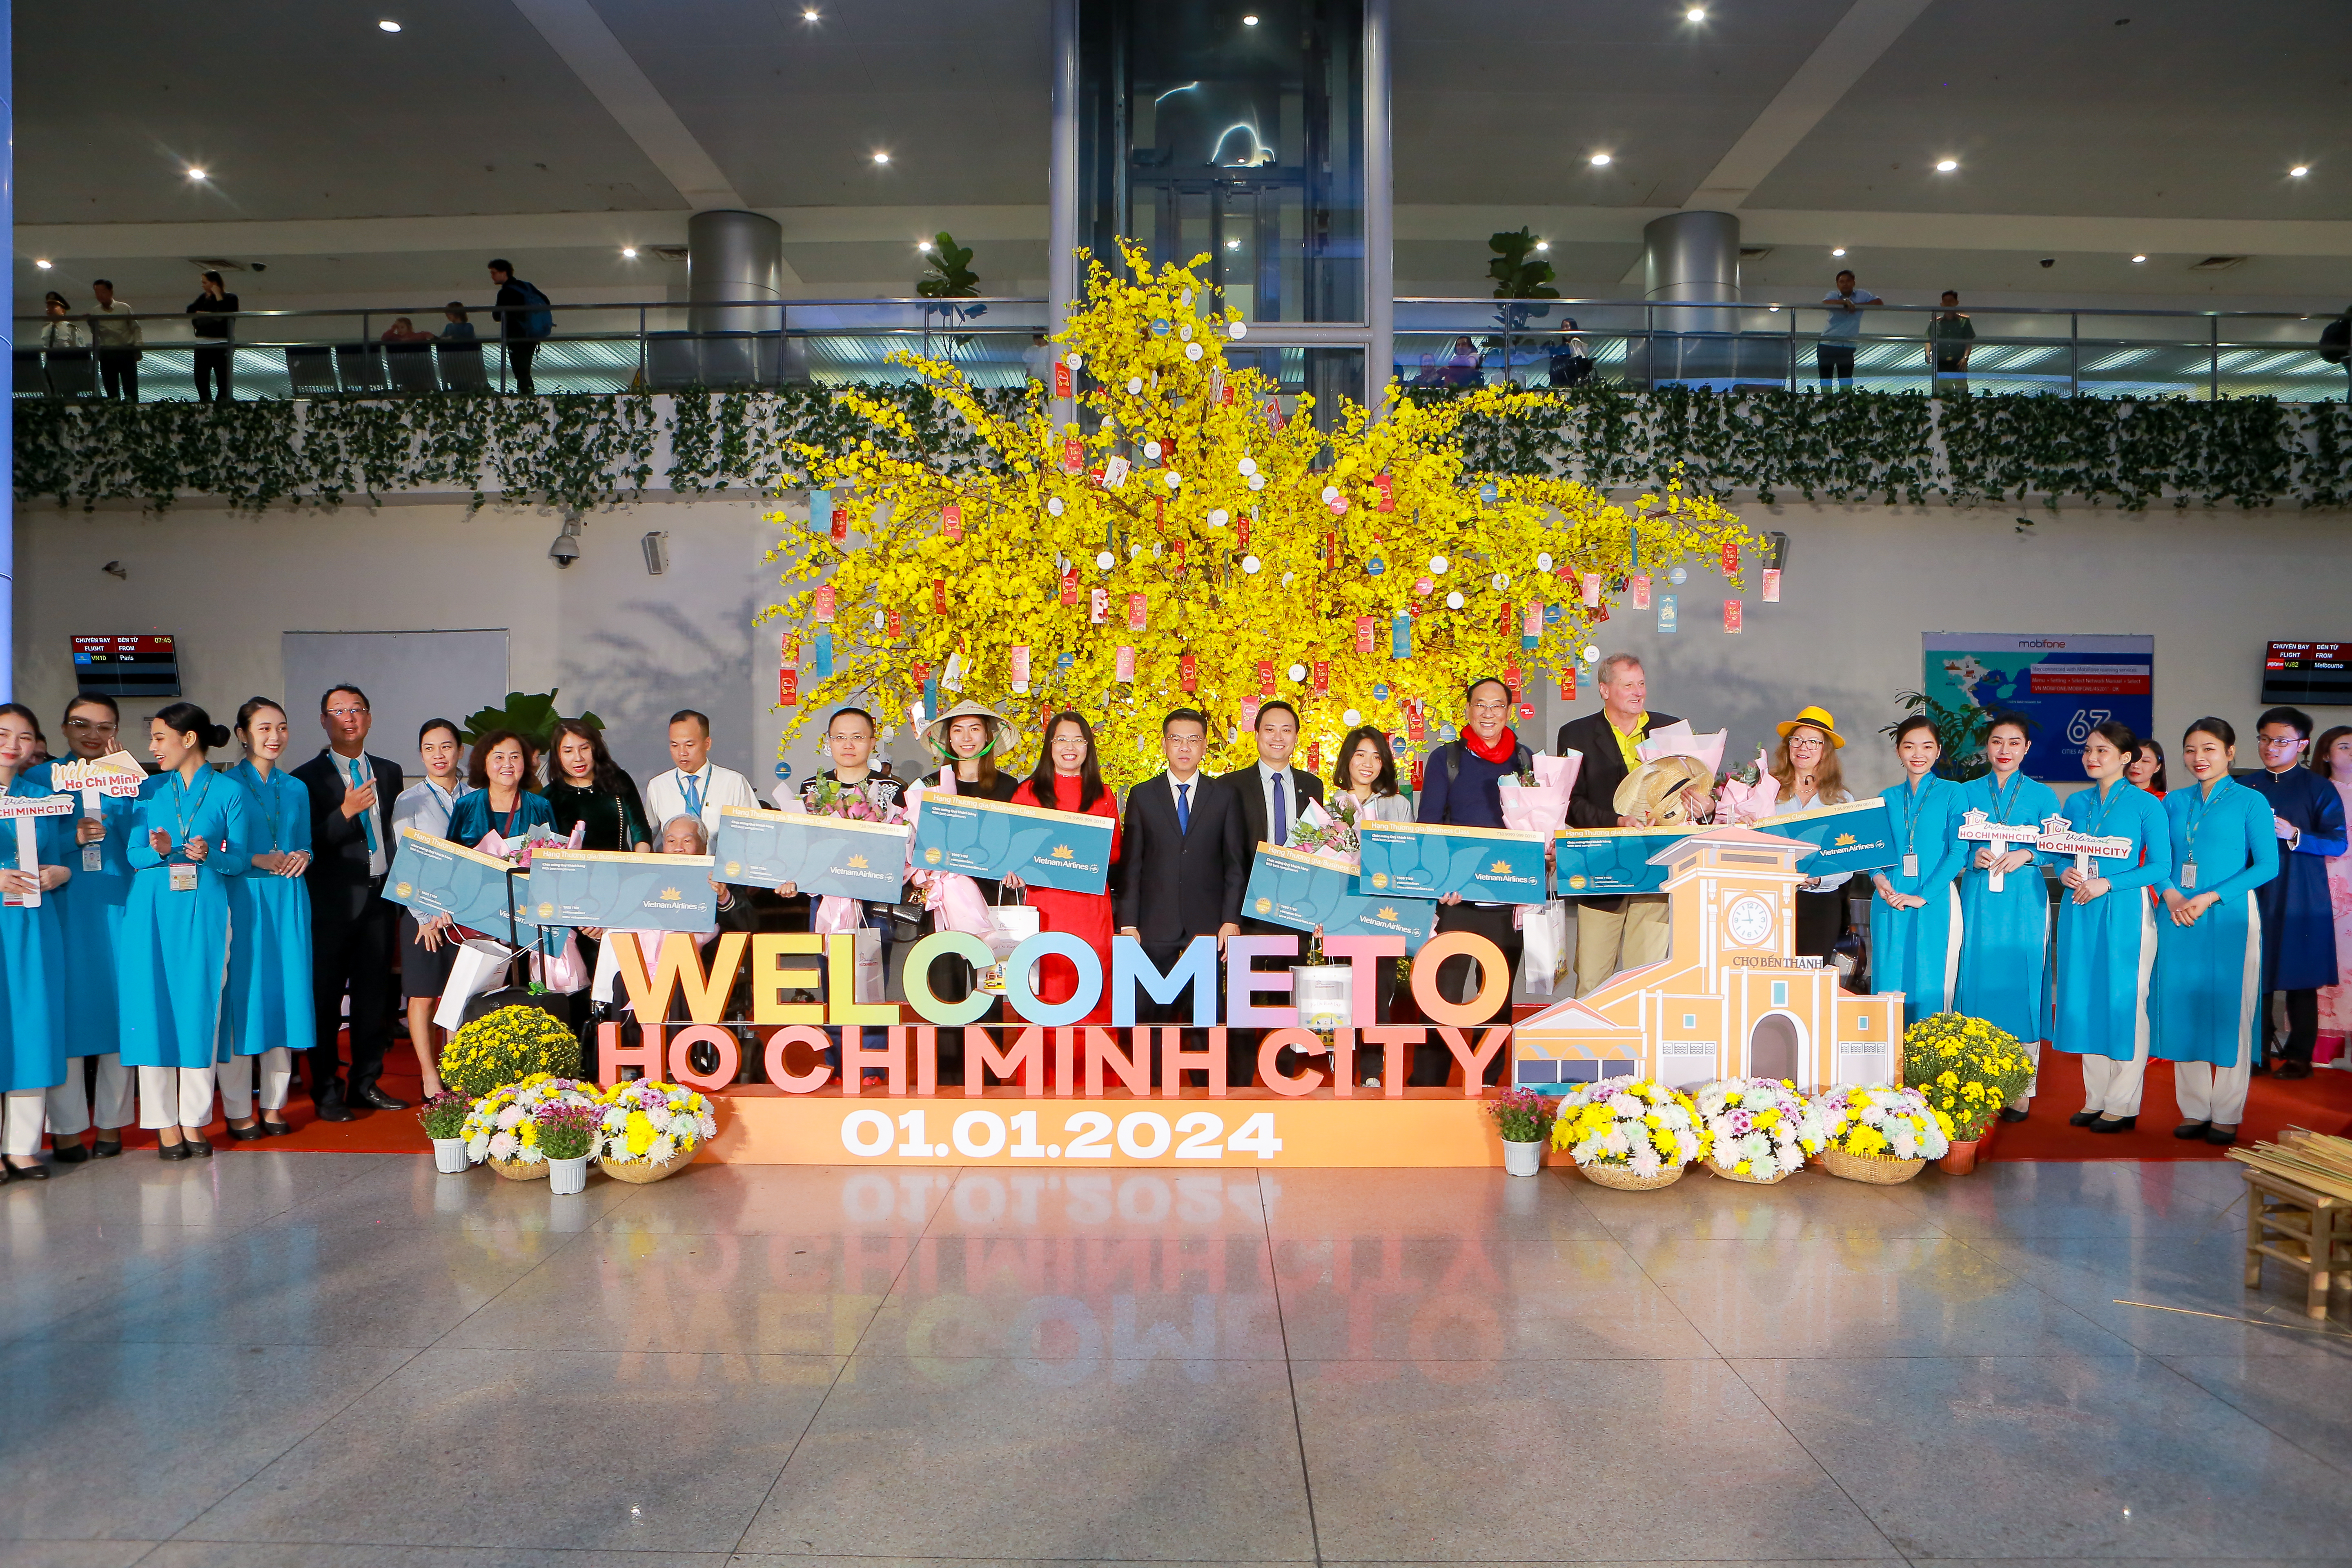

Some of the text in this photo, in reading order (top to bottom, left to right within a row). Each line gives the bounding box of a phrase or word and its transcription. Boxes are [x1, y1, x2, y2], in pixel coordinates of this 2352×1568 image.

[2019, 639, 2065, 648] mobifone
[53, 760, 122, 781] Welcome
[65, 780, 82, 789] Ho
[86, 777, 106, 787] Chi
[109, 774, 140, 785] Minh
[111, 785, 137, 796] City
[3, 797, 52, 805] Vibrant
[933, 794, 1036, 816] Hạng Thương gia/Business Class
[17, 806, 45, 815] MINH
[47, 805, 72, 813] CITY
[732, 808, 831, 826] Hạng Thương gia/Business Class
[1372, 822, 1388, 831] Hạng
[1389, 823, 1414, 833] Thương
[1415, 825, 1453, 835] gia/Business
[1610, 828, 1650, 836] gia/Business
[1984, 823, 2022, 831] Vibrant
[2066, 833, 2110, 844] Vibrant
[413, 831, 432, 844] Hạng
[430, 837, 456, 853] Thương
[454, 846, 494, 866] gia/Business
[2056, 843, 2073, 851] CHI
[2075, 844, 2101, 854] MINH
[2103, 847, 2129, 857] CITY
[543, 851, 560, 859] Hạng
[560, 851, 586, 860] Thương
[586, 853, 626, 862] gia/Business
[1267, 846, 1360, 875] Hạng Thương gia/Business Cla
[1733, 954, 1823, 969] CHỢ BẾN THÀNH
[609, 930, 1510, 1027] WELCOME TO
[598, 1022, 1510, 1096] HO CHI MINH CITY
[841, 1109, 1283, 1159] 01.01.2024
